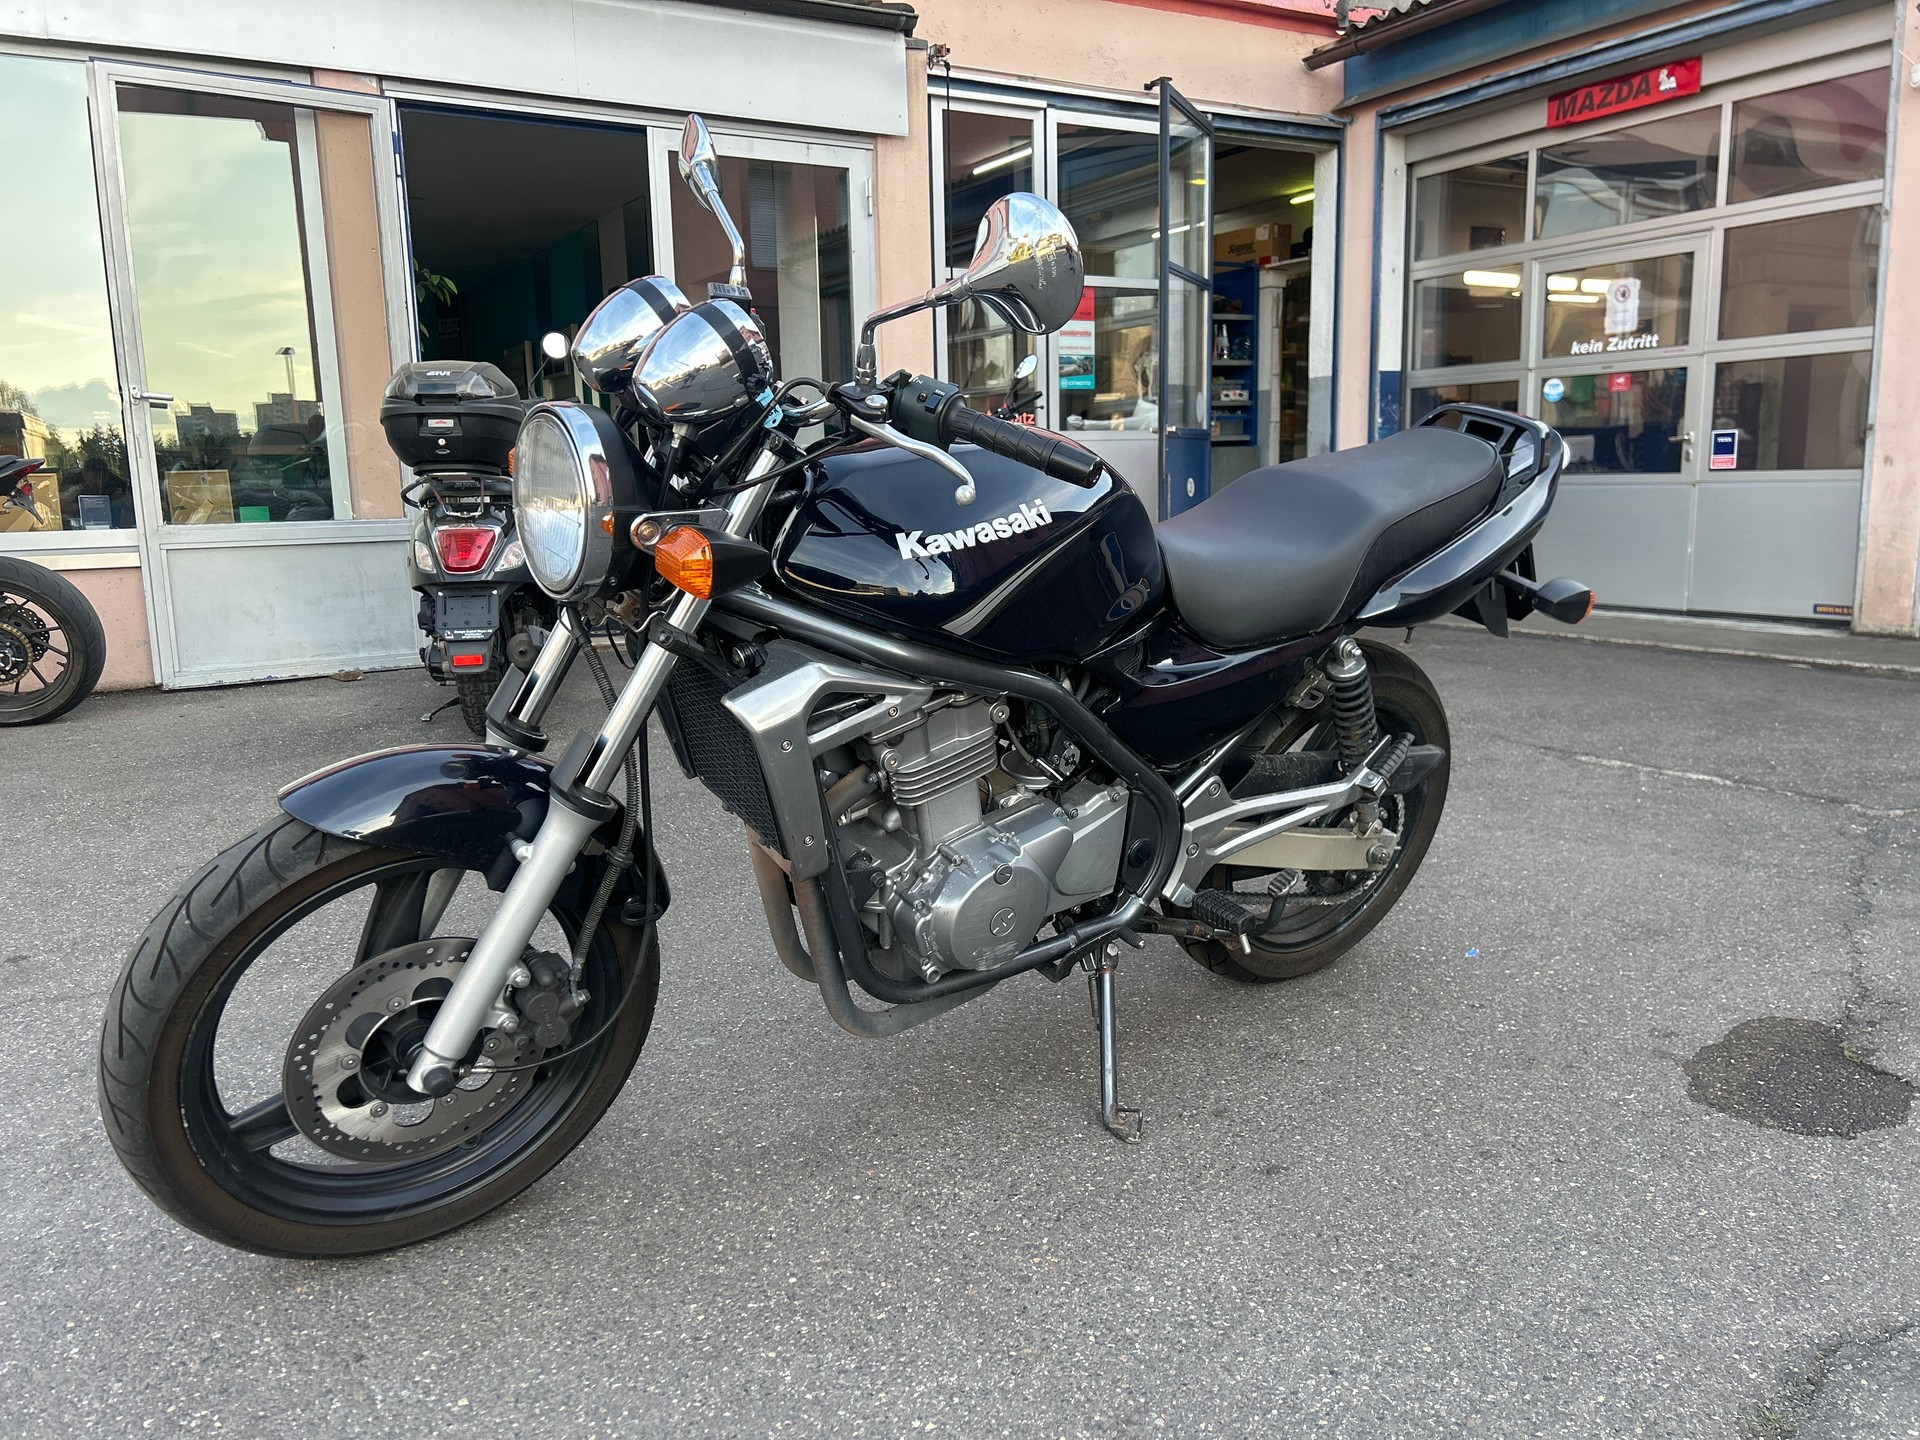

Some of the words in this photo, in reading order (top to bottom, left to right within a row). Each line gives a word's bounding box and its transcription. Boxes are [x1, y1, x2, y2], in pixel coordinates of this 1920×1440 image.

[1555, 73, 1651, 121] MAZDA
[1570, 339, 1603, 355] kein
[1606, 333, 1659, 352] Zutritt
[895, 498, 1053, 560] Kawasaki
